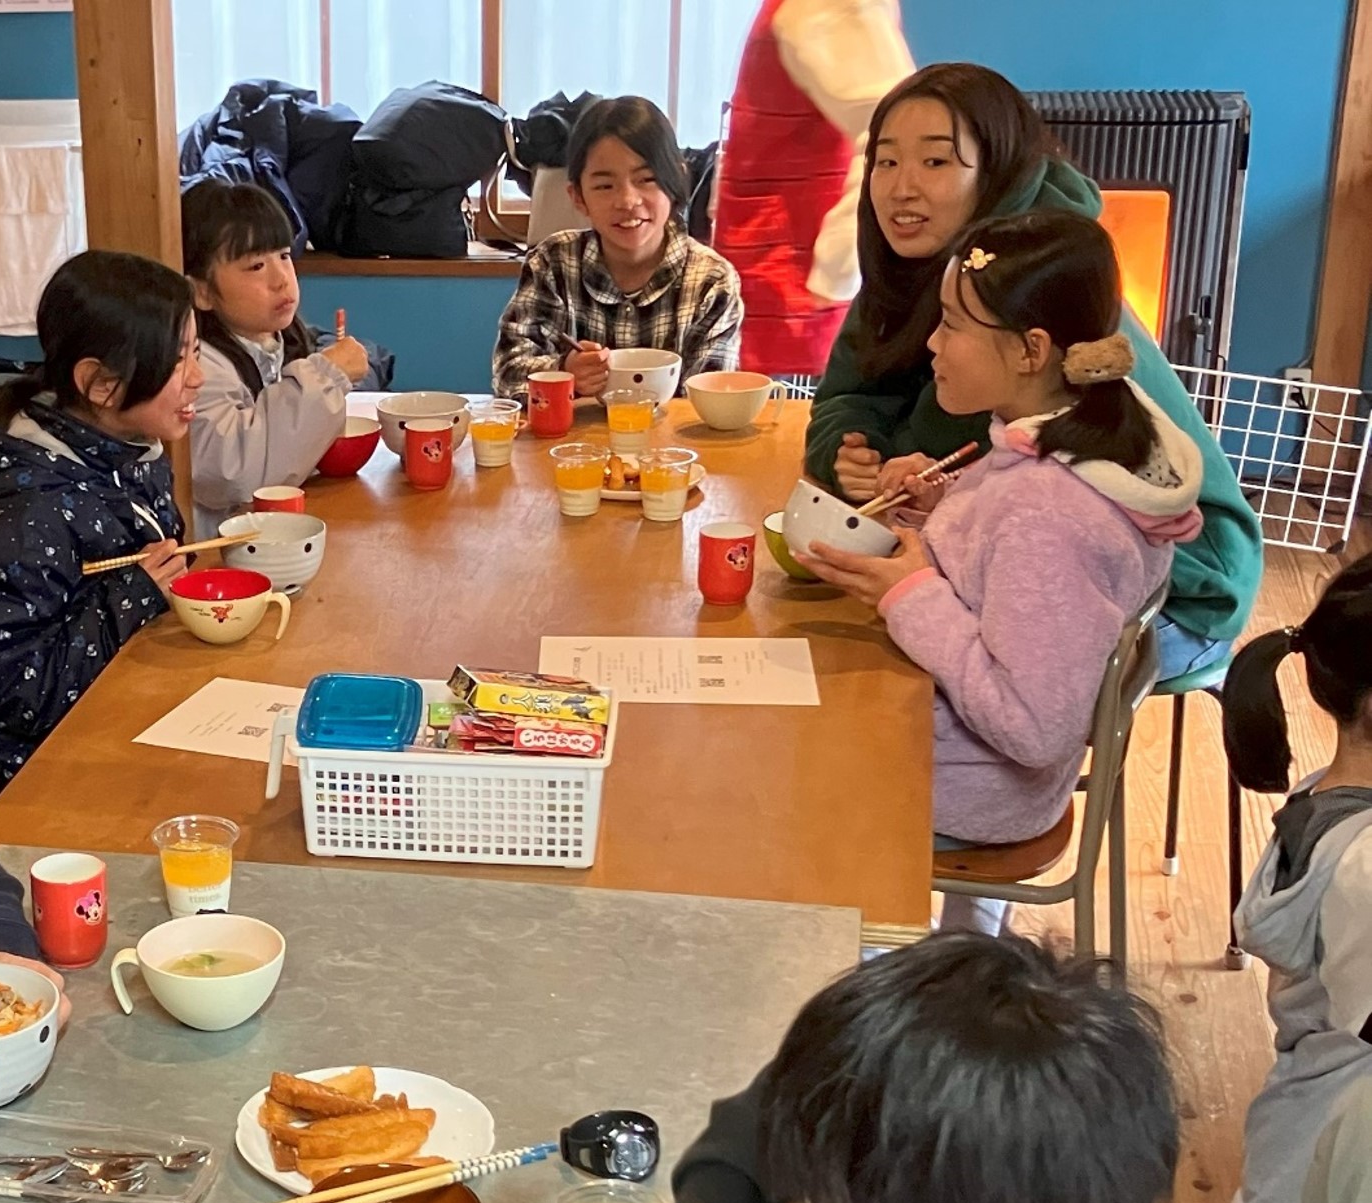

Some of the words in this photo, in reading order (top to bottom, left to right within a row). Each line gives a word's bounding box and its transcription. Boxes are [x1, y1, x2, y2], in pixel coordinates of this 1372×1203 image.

[520, 730, 595, 750] いろはかるた
